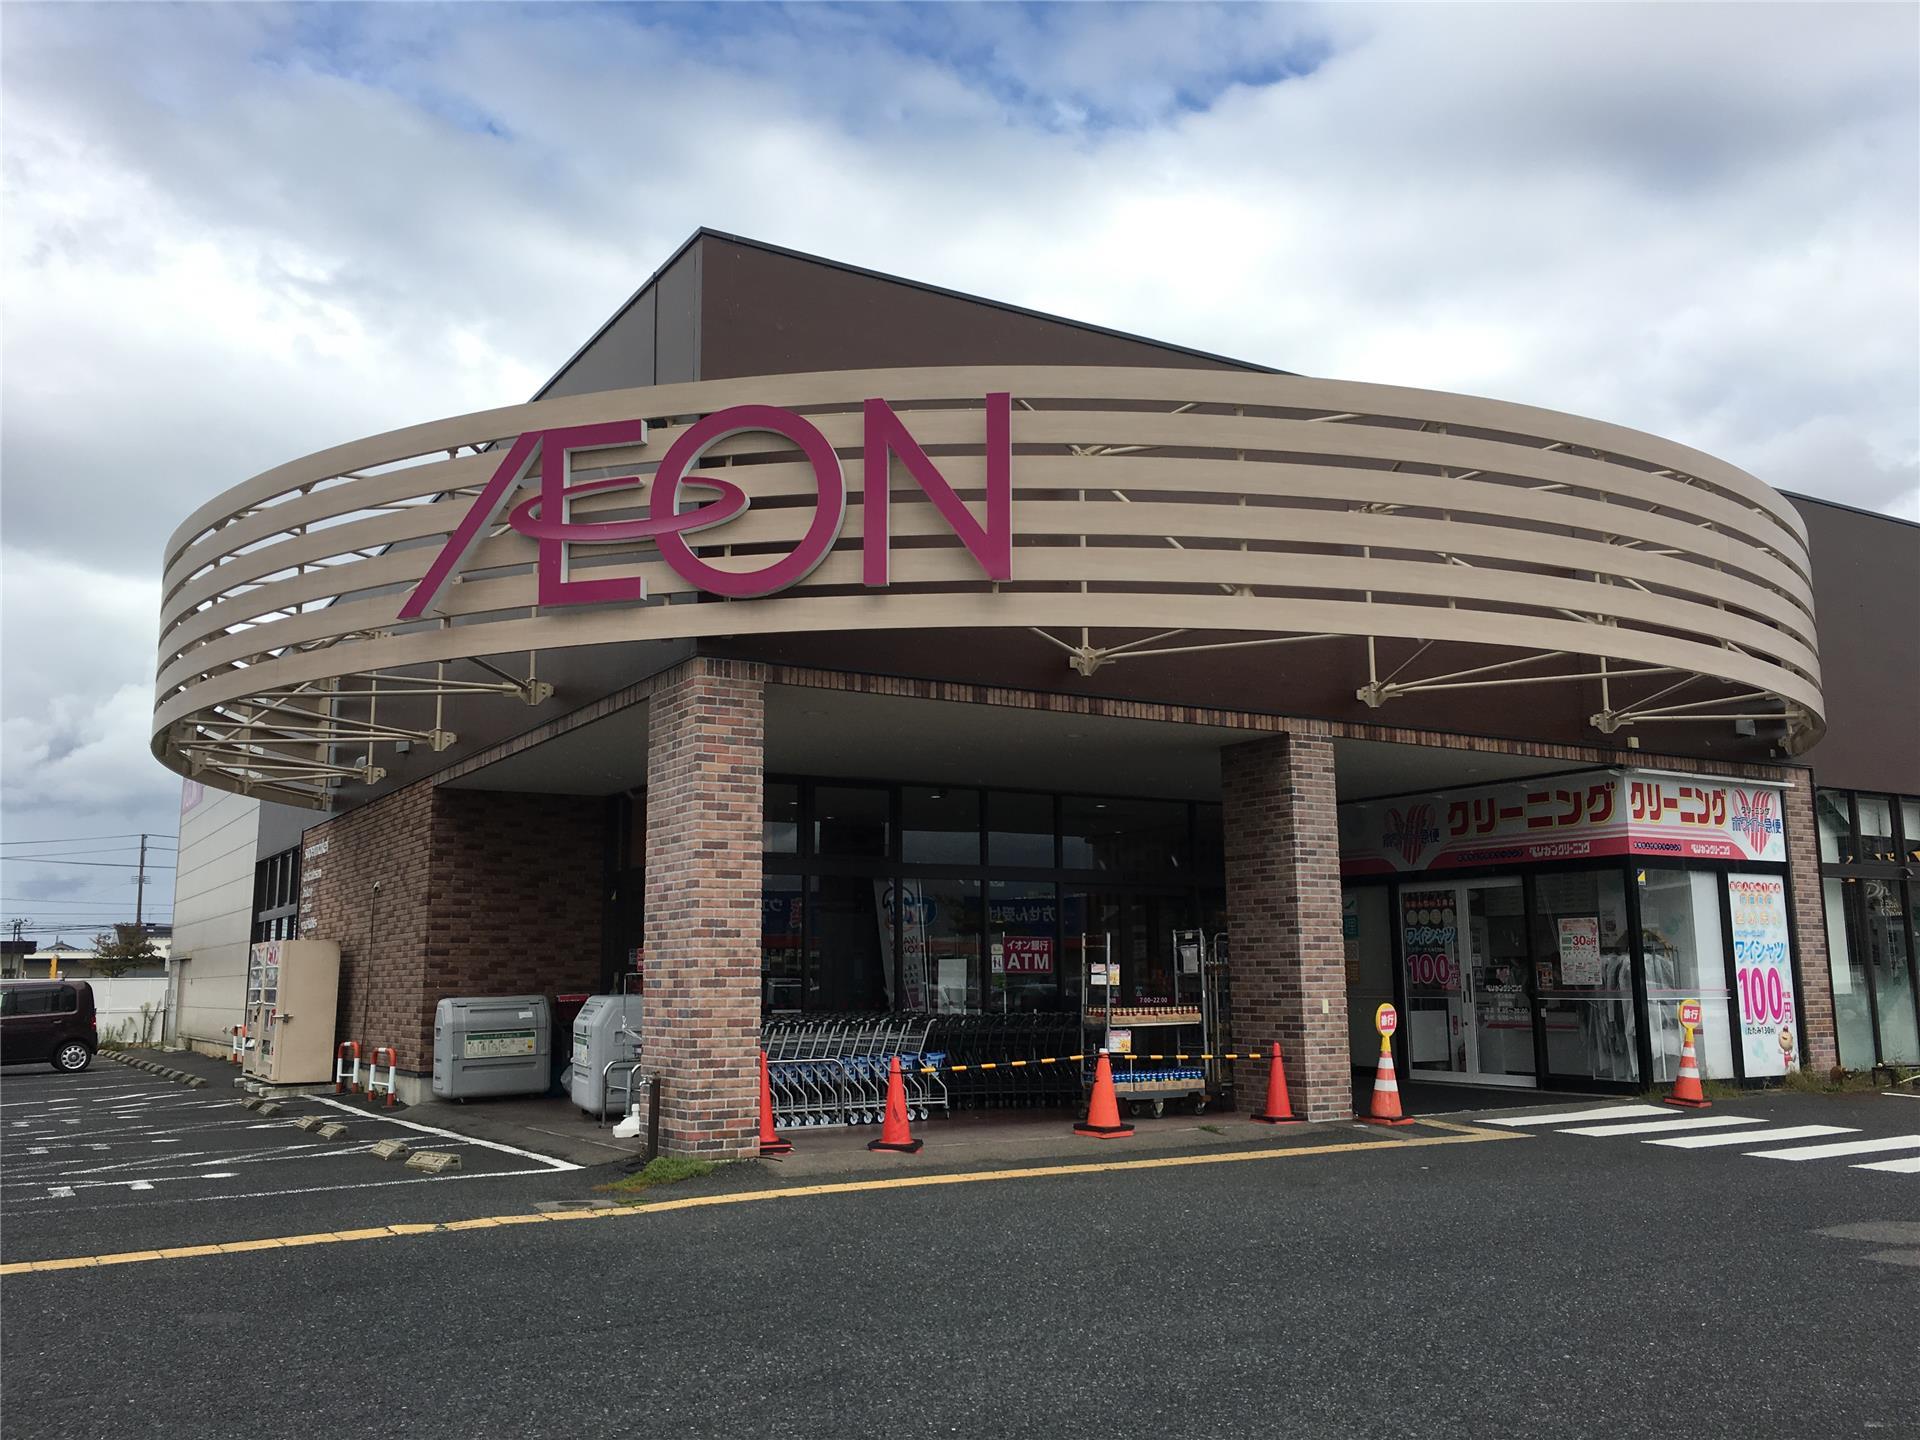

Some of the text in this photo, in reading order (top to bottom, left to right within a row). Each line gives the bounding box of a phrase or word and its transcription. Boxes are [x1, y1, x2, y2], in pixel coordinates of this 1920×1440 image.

[1448, 781, 1616, 836] クリーニング
[1630, 782, 1727, 826] クリーニング
[1731, 816, 1782, 834] ホワイト急便
[1007, 940, 1049, 951] イオン銀行
[1735, 940, 1786, 962] ワイシャツ
[1007, 953, 1049, 969] ATM
